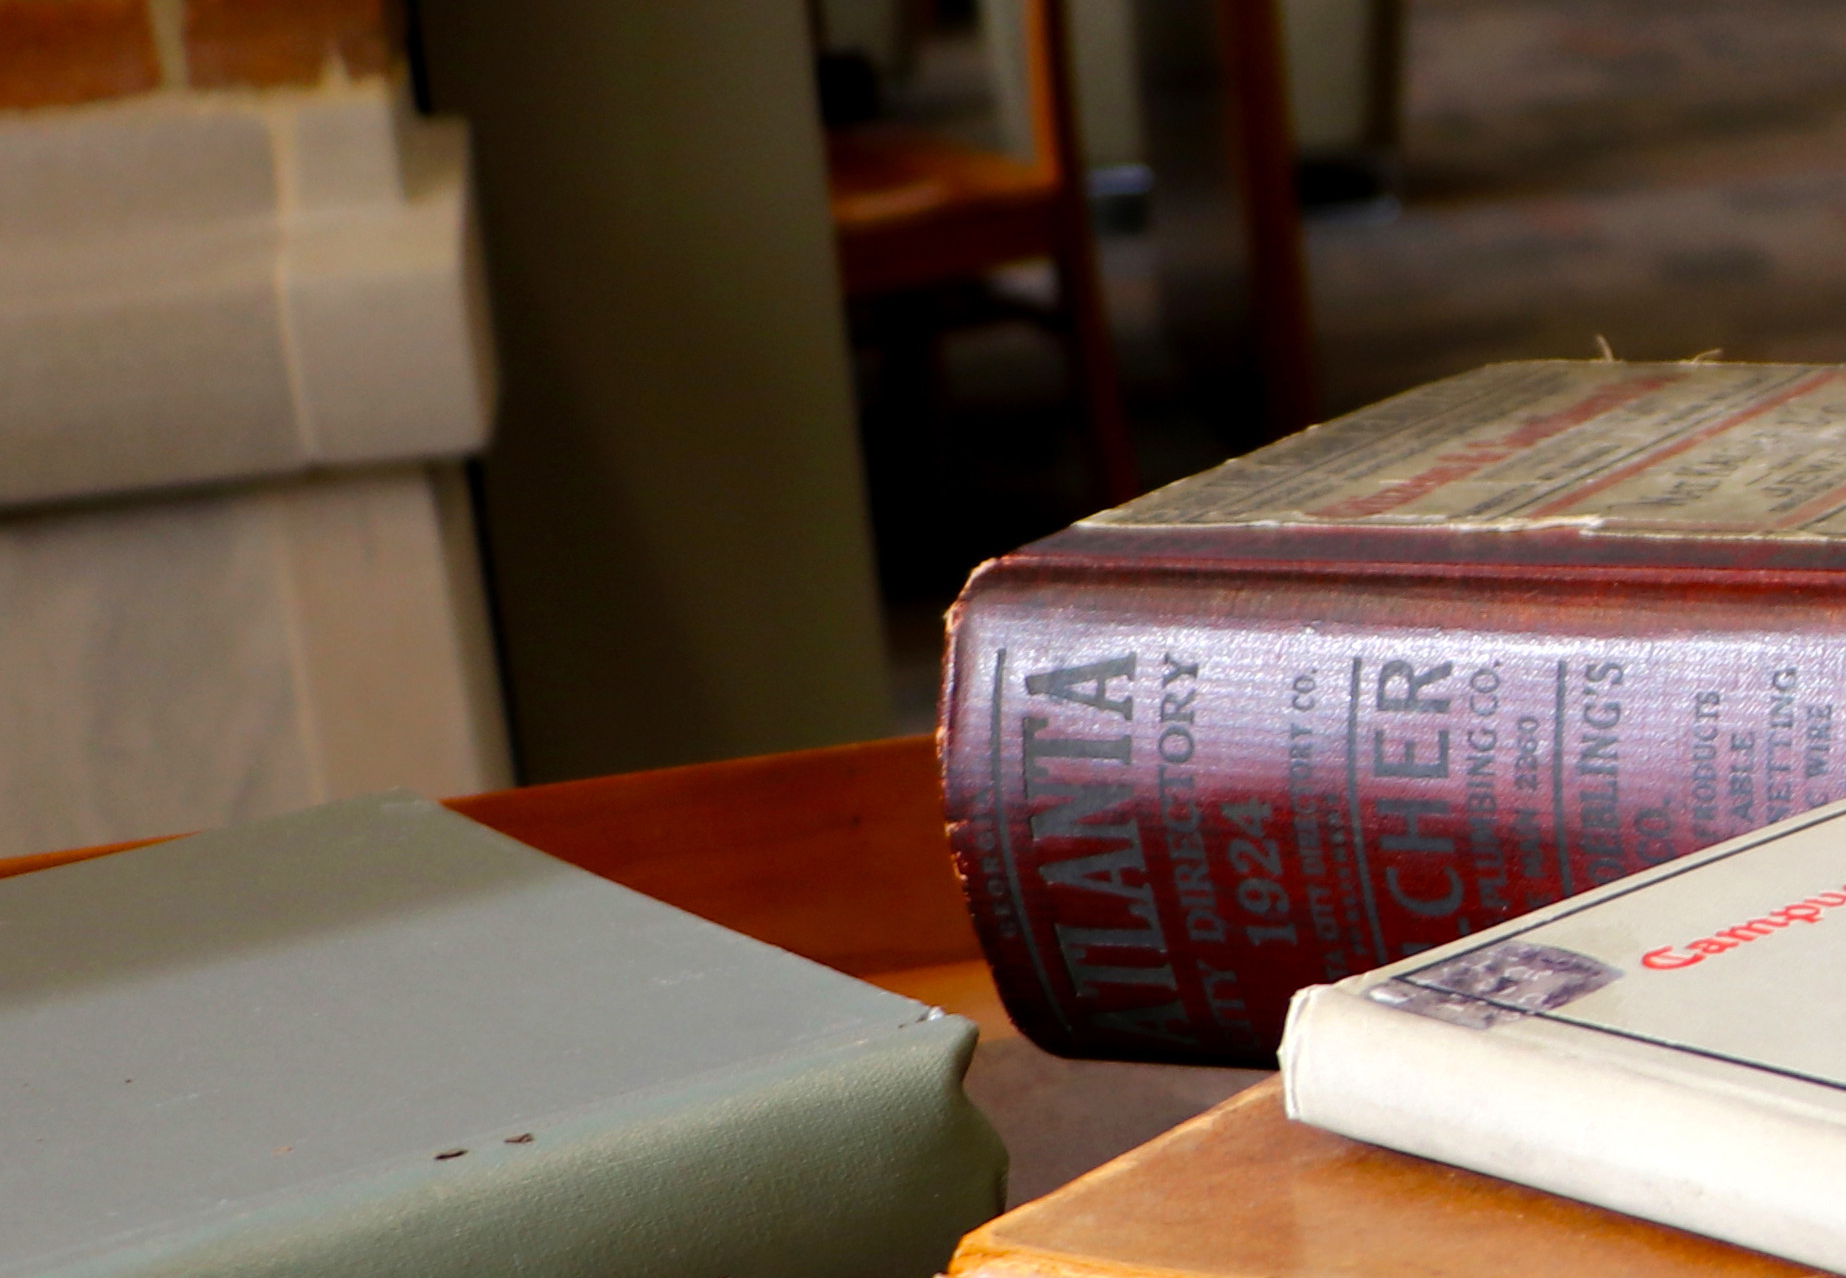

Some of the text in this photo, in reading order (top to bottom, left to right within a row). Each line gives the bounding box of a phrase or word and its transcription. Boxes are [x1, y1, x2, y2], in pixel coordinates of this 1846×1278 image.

[1471, 660, 1502, 716] CO.
[1804, 704, 1831, 778] WIRE
[1023, 651, 1197, 1043] ATLANTA
[1289, 667, 1339, 939] CITY DIRECTORY CO.
[1580, 658, 1624, 887] OEBLING'S
[1635, 797, 1673, 863] CO.
[1732, 731, 1756, 820] ABLE
[972, 787, 1015, 938] GEORGIA
[1158, 652, 1264, 1053] CITY DIRECTORY
[1222, 798, 1299, 947] 1924
